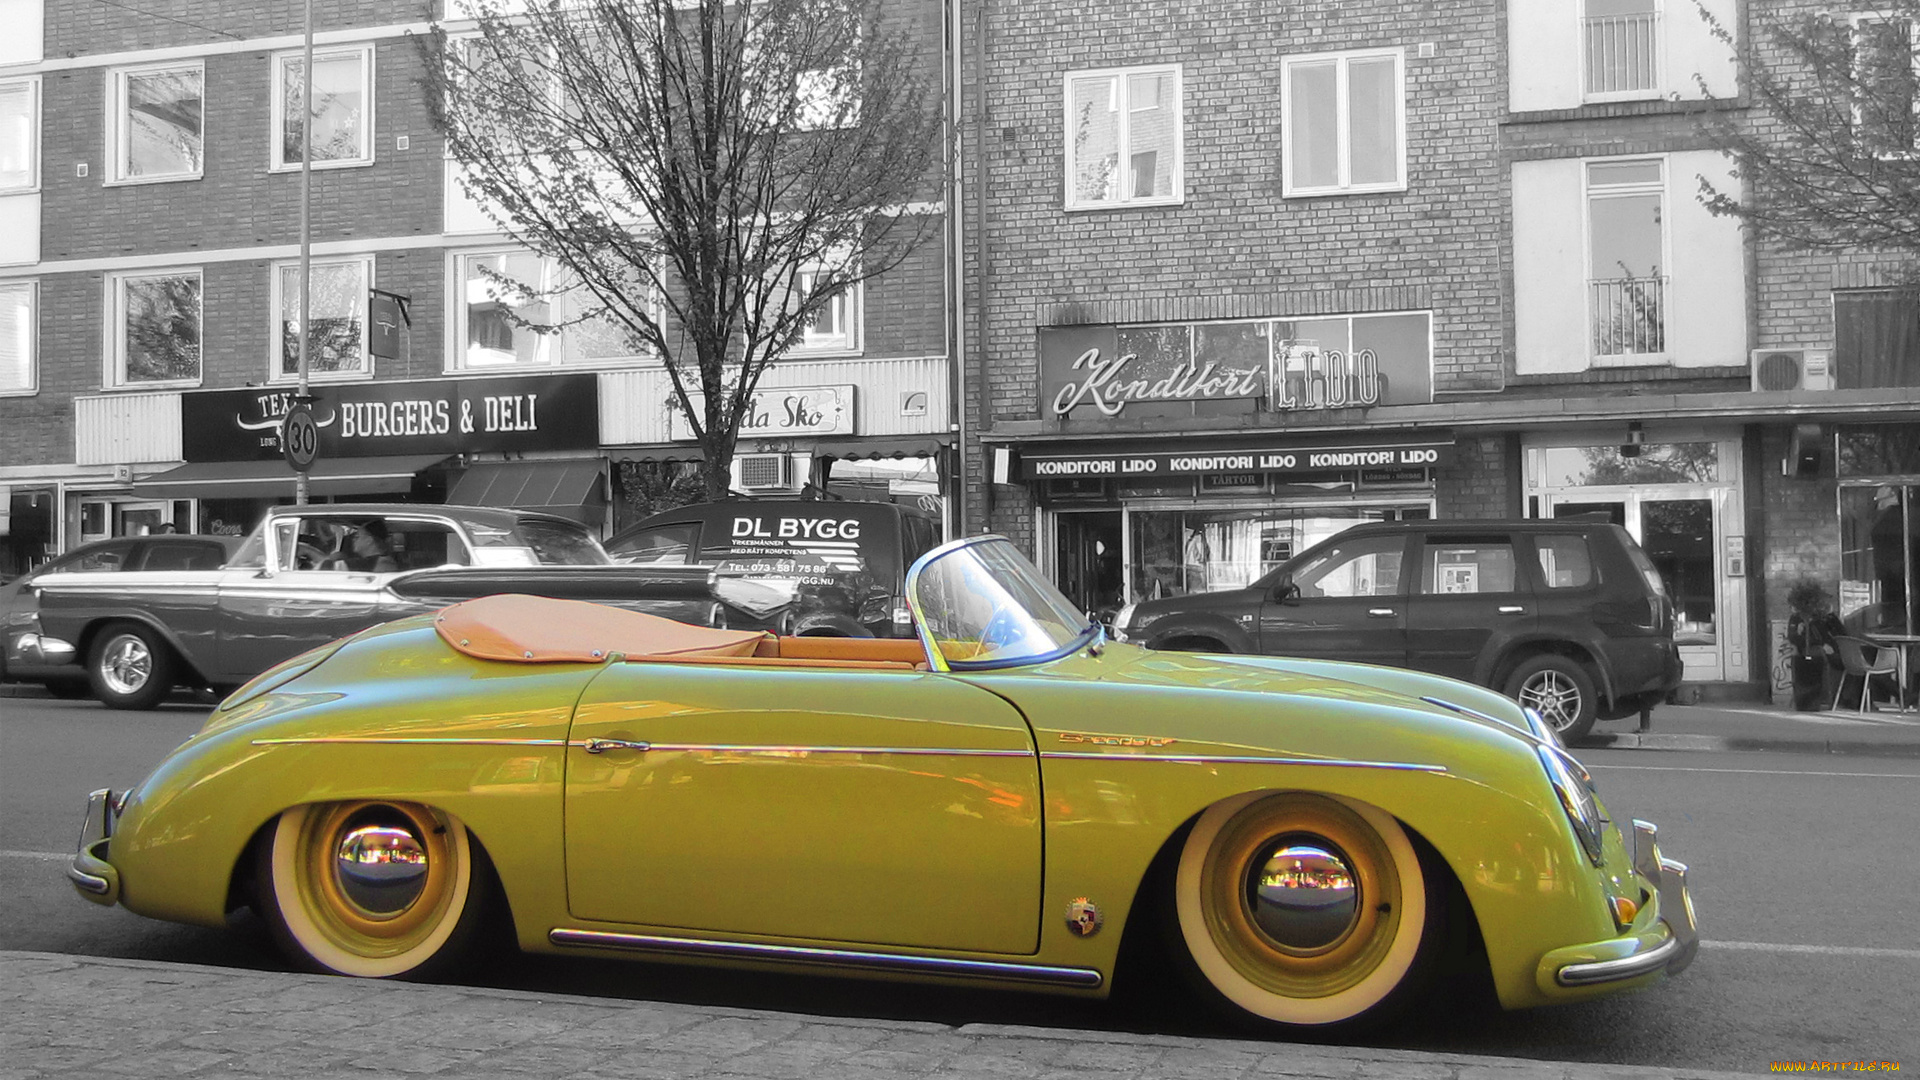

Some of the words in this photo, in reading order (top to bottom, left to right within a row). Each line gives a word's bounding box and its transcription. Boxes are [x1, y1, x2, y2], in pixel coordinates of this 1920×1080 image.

[1276, 349, 1378, 407] LIDO
[258, 392, 312, 417] TEX
[341, 400, 449, 437] BURGERS
[460, 399, 475, 434] &
[484, 394, 538, 432] DELI
[779, 395, 823, 428] Sko
[290, 421, 315, 455] 30
[1036, 460, 1116, 474] KONDITORI
[1122, 459, 1157, 473] LIDO
[1170, 455, 1254, 471] KONDITORI
[1260, 454, 1296, 468] LIDO
[1310, 451, 1395, 467] KONDITORI
[1400, 449, 1438, 464] LIDO
[732, 517, 772, 538] DL
[778, 518, 861, 539] BYGG
[729, 563, 749, 572] TEL:
[798, 564, 811, 573] 75
